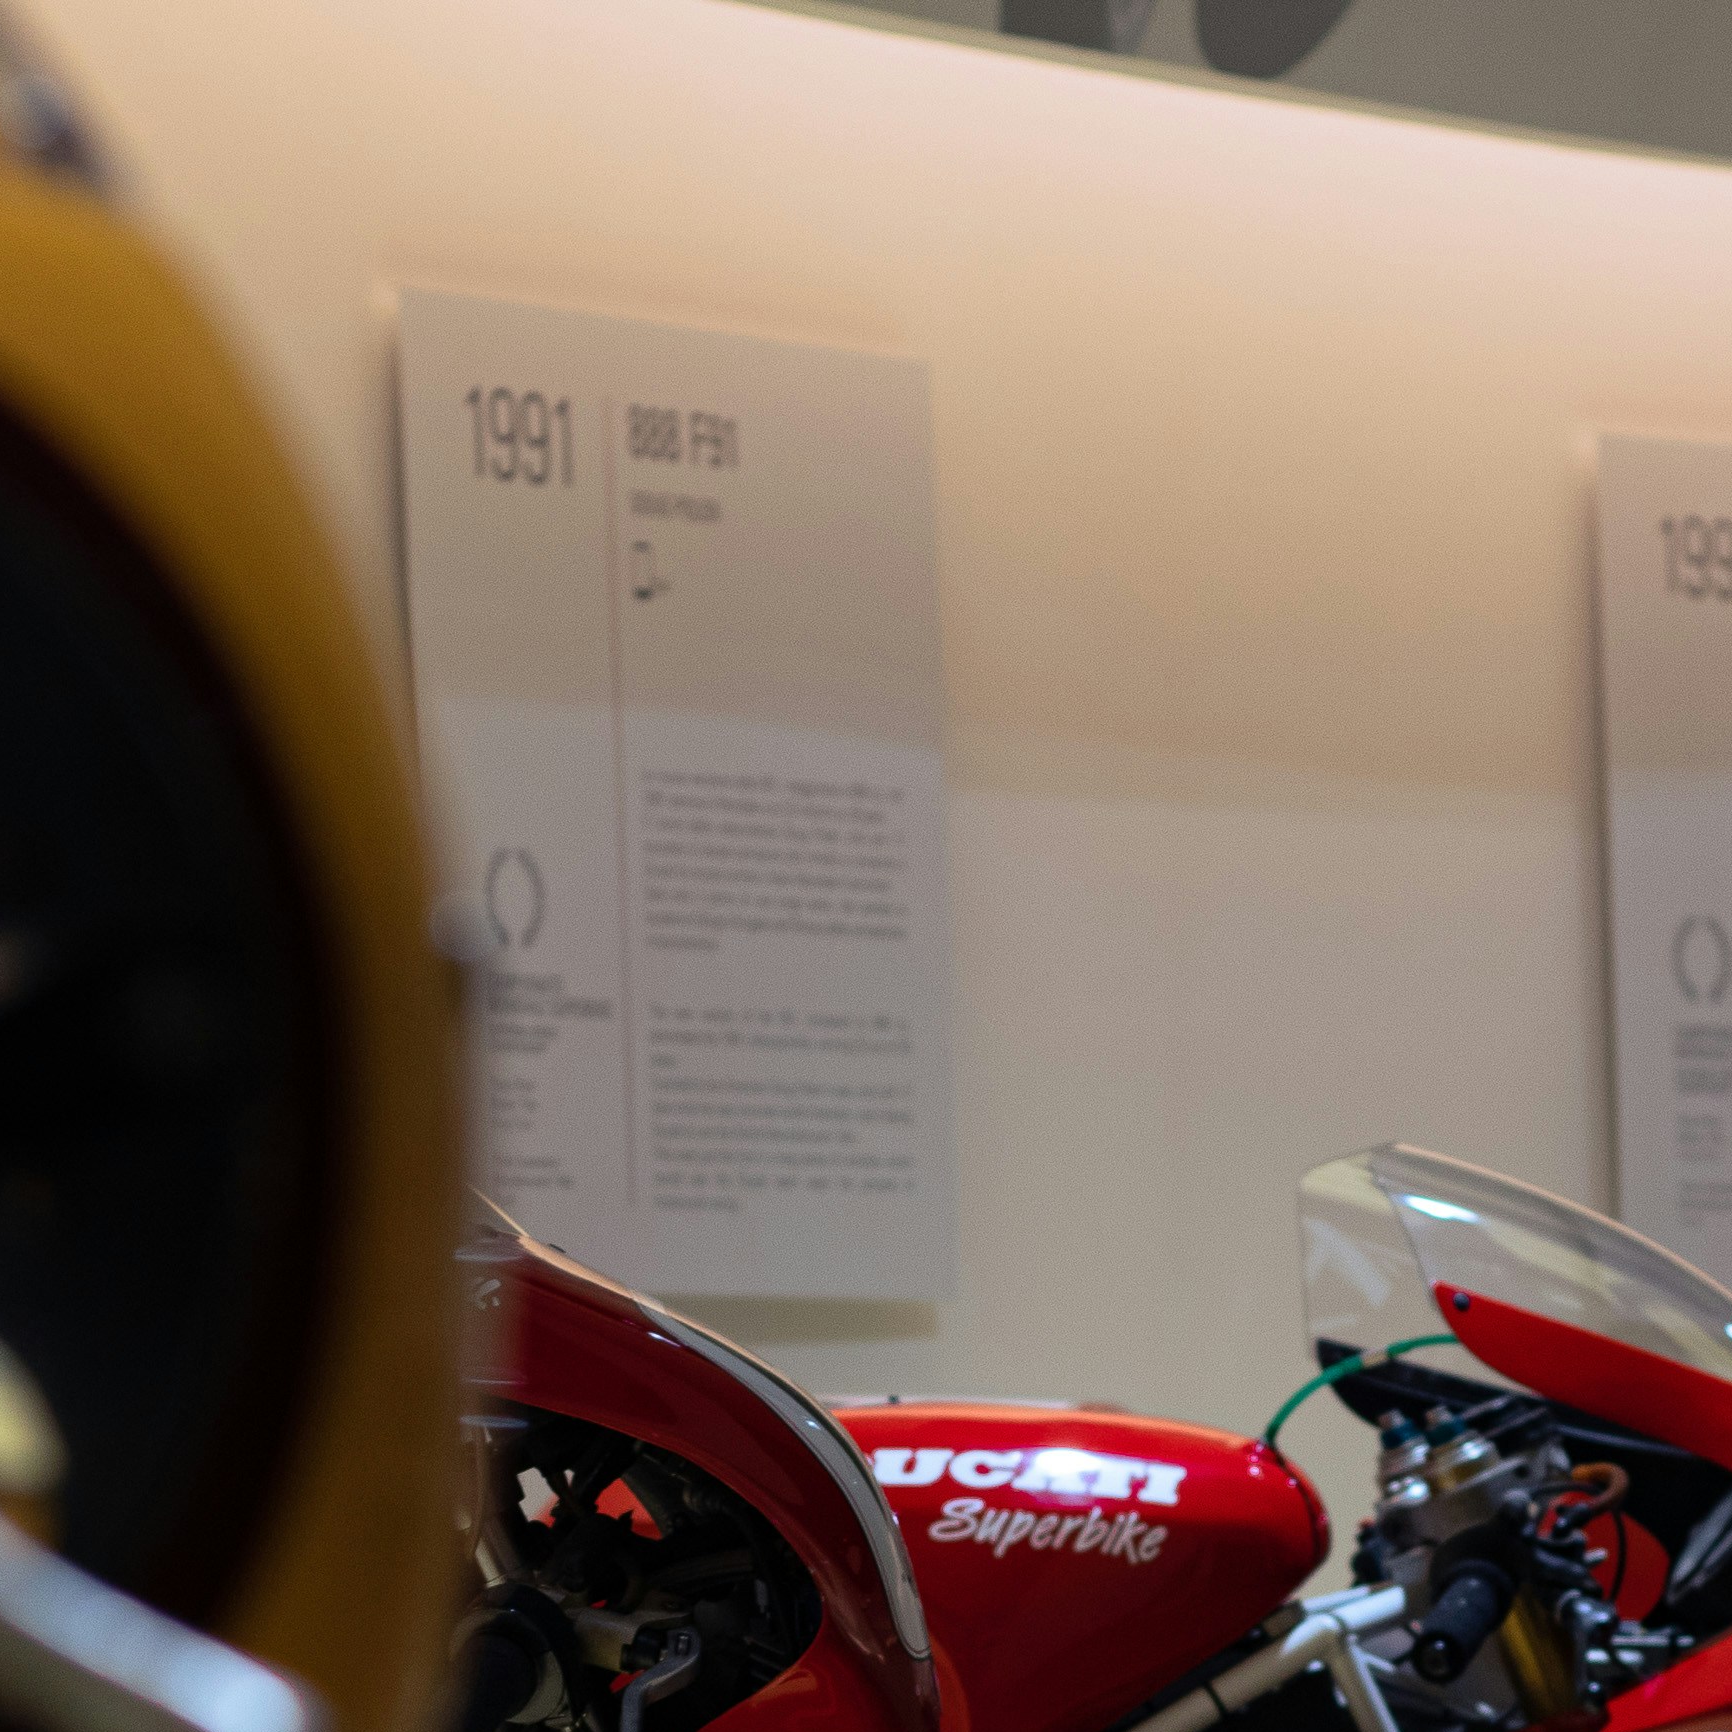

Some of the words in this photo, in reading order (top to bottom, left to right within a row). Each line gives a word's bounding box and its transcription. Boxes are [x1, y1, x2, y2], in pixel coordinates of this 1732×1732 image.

[466, 384, 576, 489] 1991
[868, 1447, 1187, 1505] UCATI
[928, 1497, 1169, 1565] Superbike
